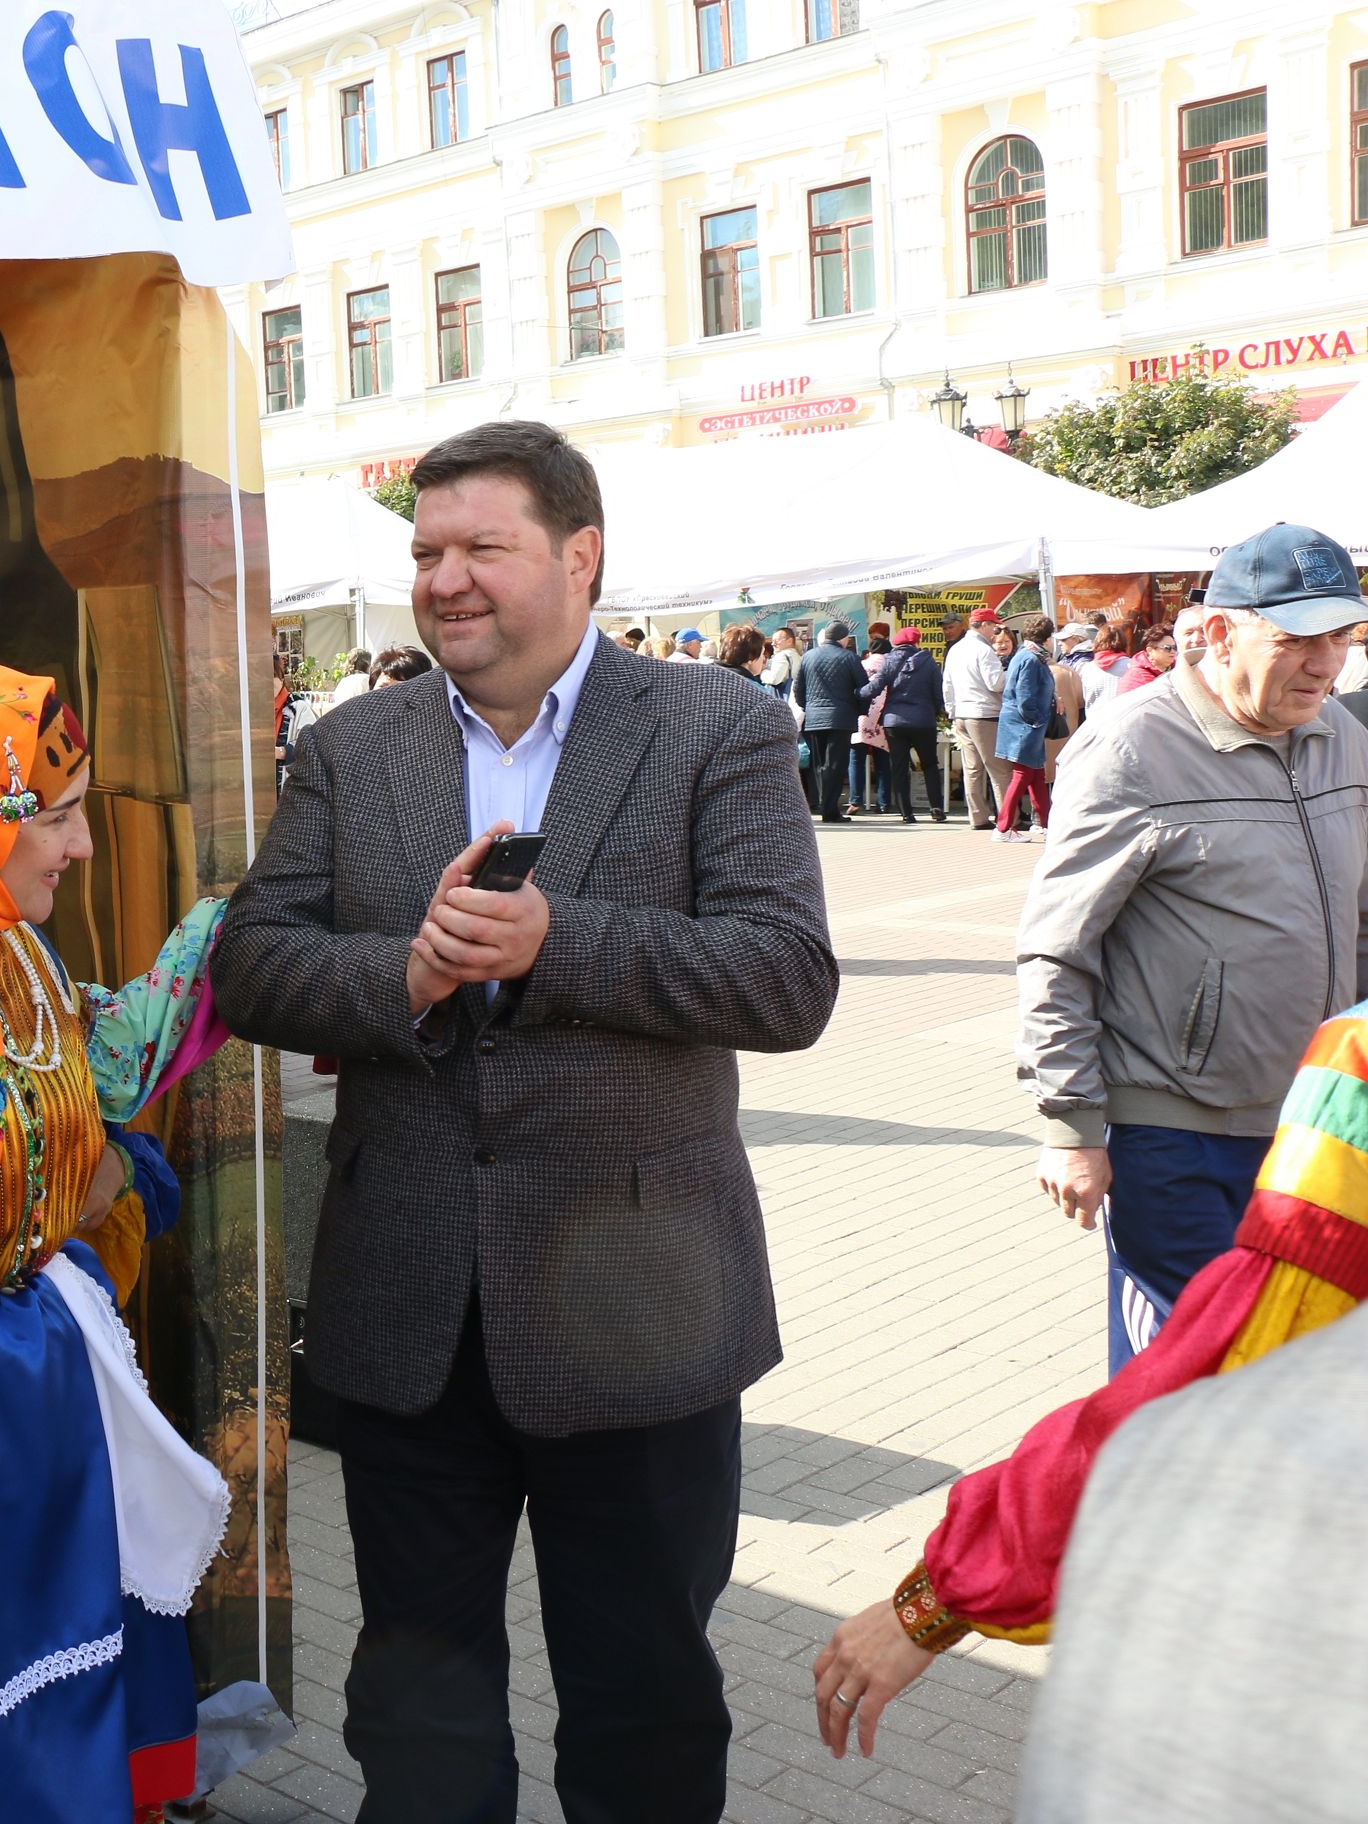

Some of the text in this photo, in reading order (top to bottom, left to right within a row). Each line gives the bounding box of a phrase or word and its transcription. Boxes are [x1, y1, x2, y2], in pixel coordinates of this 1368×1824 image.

[1128, 330, 1355, 384] ЦЕНТР СЛУХА
[740, 376, 810, 402] ЦЕНТР
[710, 397, 843, 431] ЭСТЕТИЧЕСКОЙ
[945, 591, 984, 601] ГРУШИ
